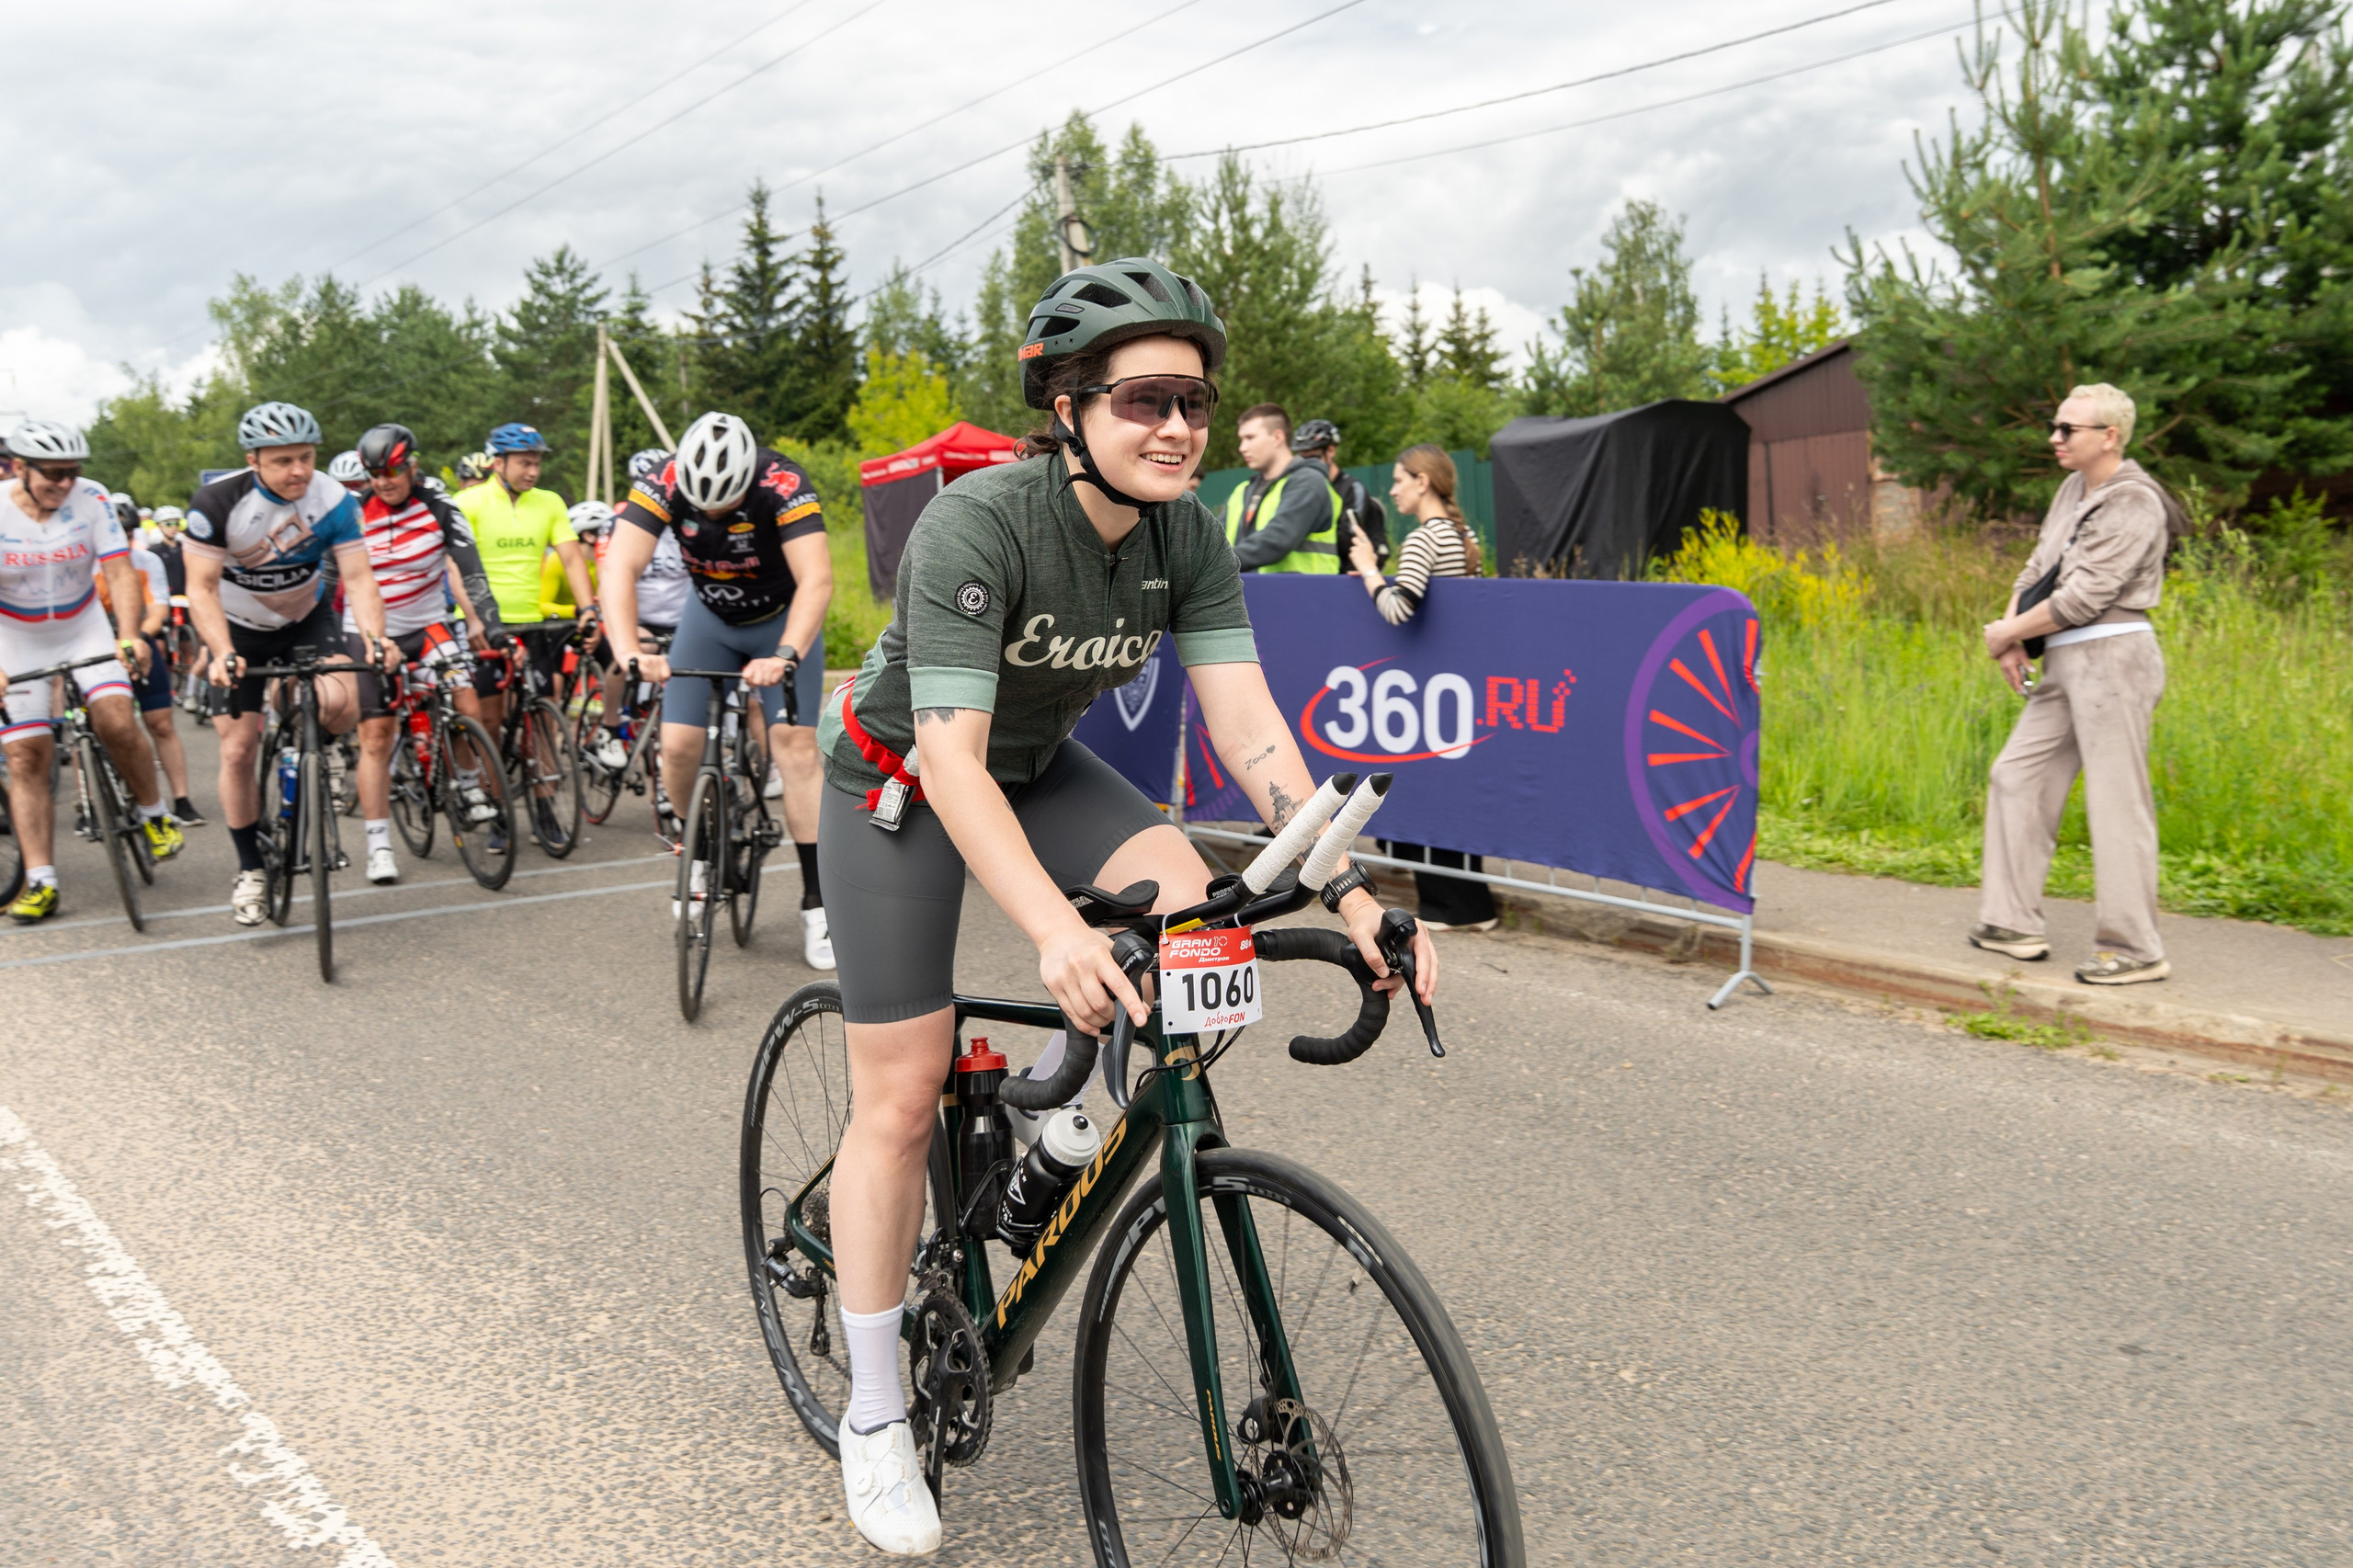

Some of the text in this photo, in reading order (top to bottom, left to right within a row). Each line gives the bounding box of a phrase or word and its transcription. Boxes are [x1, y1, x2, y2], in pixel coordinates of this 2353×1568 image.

[496, 537, 536, 549] GIRA
[4, 543, 89, 566] RUSSIA
[234, 568, 312, 588] SICILIA
[1141, 577, 1169, 590] antin
[1171, 937, 1212, 949] GRAN
[1169, 947, 1222, 959] FONDO
[1181, 966, 1254, 1012] 1060
[996, 1117, 1128, 1330] PARDUS
